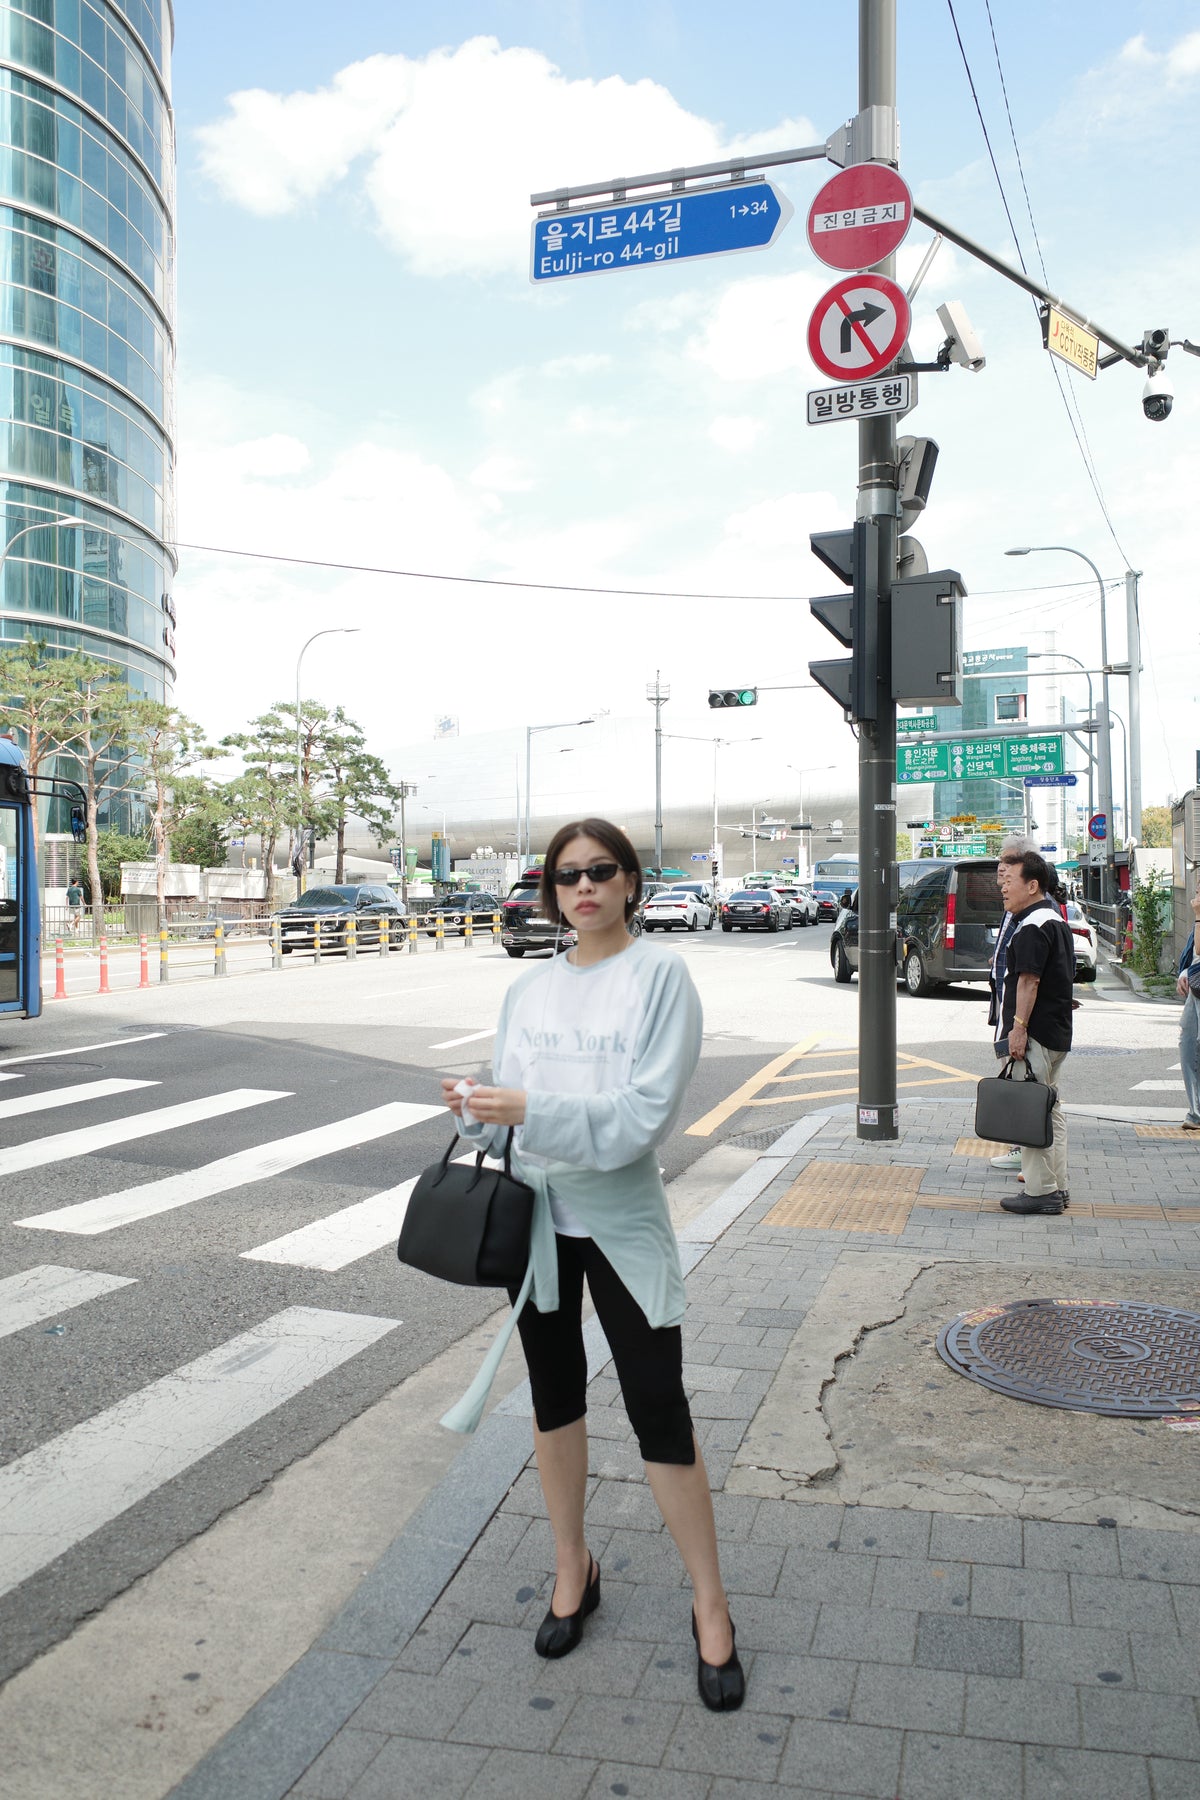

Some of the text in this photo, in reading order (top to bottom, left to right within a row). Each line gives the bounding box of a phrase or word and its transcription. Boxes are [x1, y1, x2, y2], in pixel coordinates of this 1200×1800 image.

[541, 202, 682, 252] 을지로44길
[823, 204, 897, 229] 진입금지
[540, 237, 679, 274] Eulji-ro 44-gil
[1060, 332, 1095, 371] CCTV작동중
[814, 383, 902, 417] 일방통행
[904, 747, 938, 759] 흥인지문
[965, 743, 1001, 755] 왕십리역
[1009, 742, 1057, 755] 장충체육관
[966, 760, 994, 772] 신당역
[518, 1027, 628, 1053] New York
